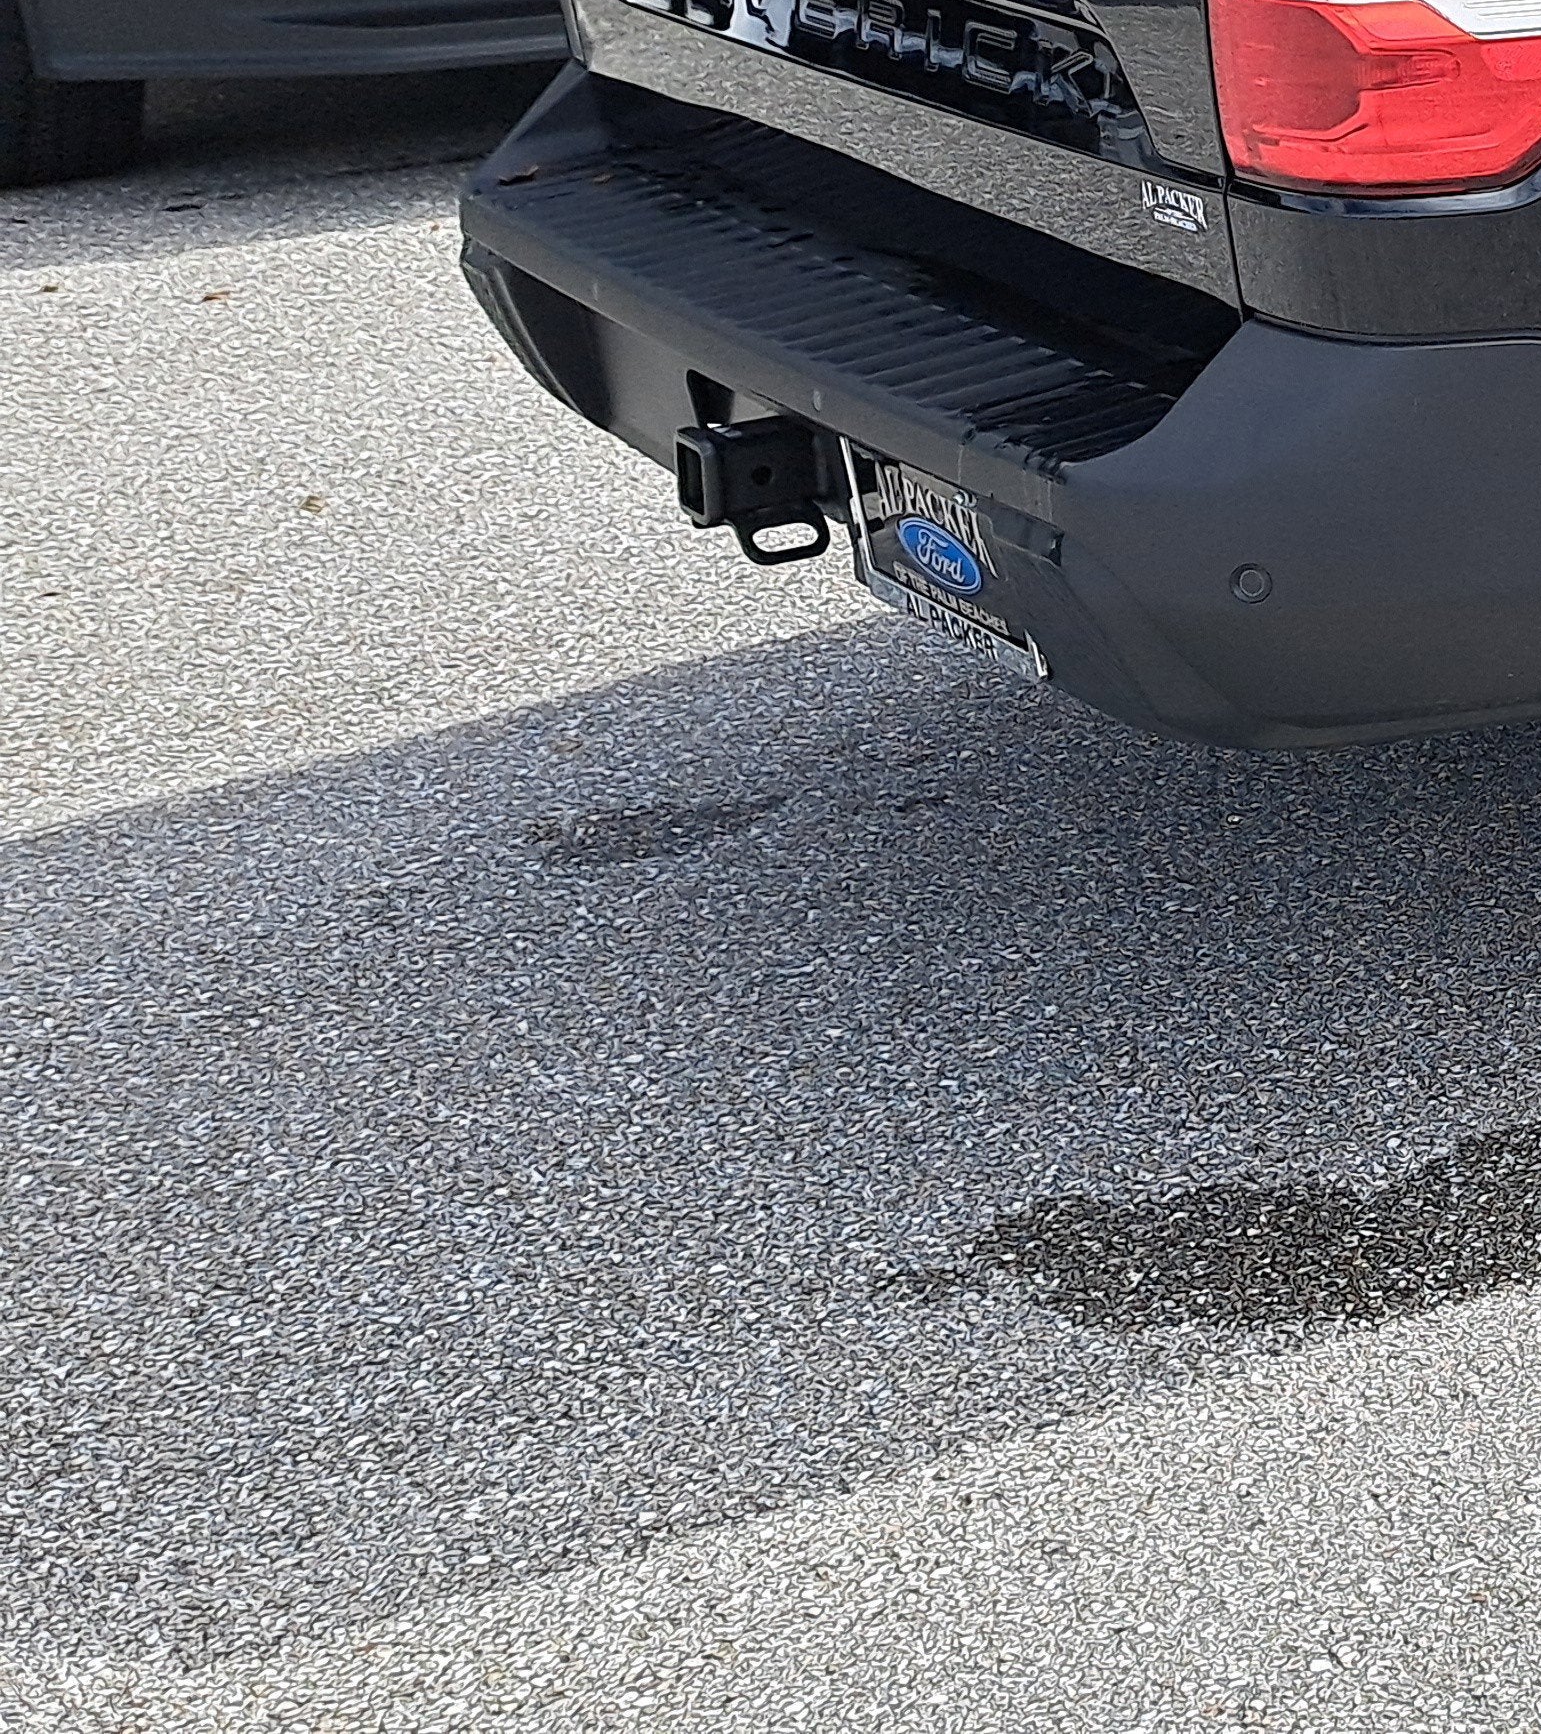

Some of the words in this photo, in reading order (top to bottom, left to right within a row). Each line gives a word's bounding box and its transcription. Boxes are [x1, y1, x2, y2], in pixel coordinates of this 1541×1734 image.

[1142, 179, 1157, 210] AL
[875, 461, 904, 518] AL
[906, 592, 929, 623] AL
[928, 603, 999, 661] PACKER
